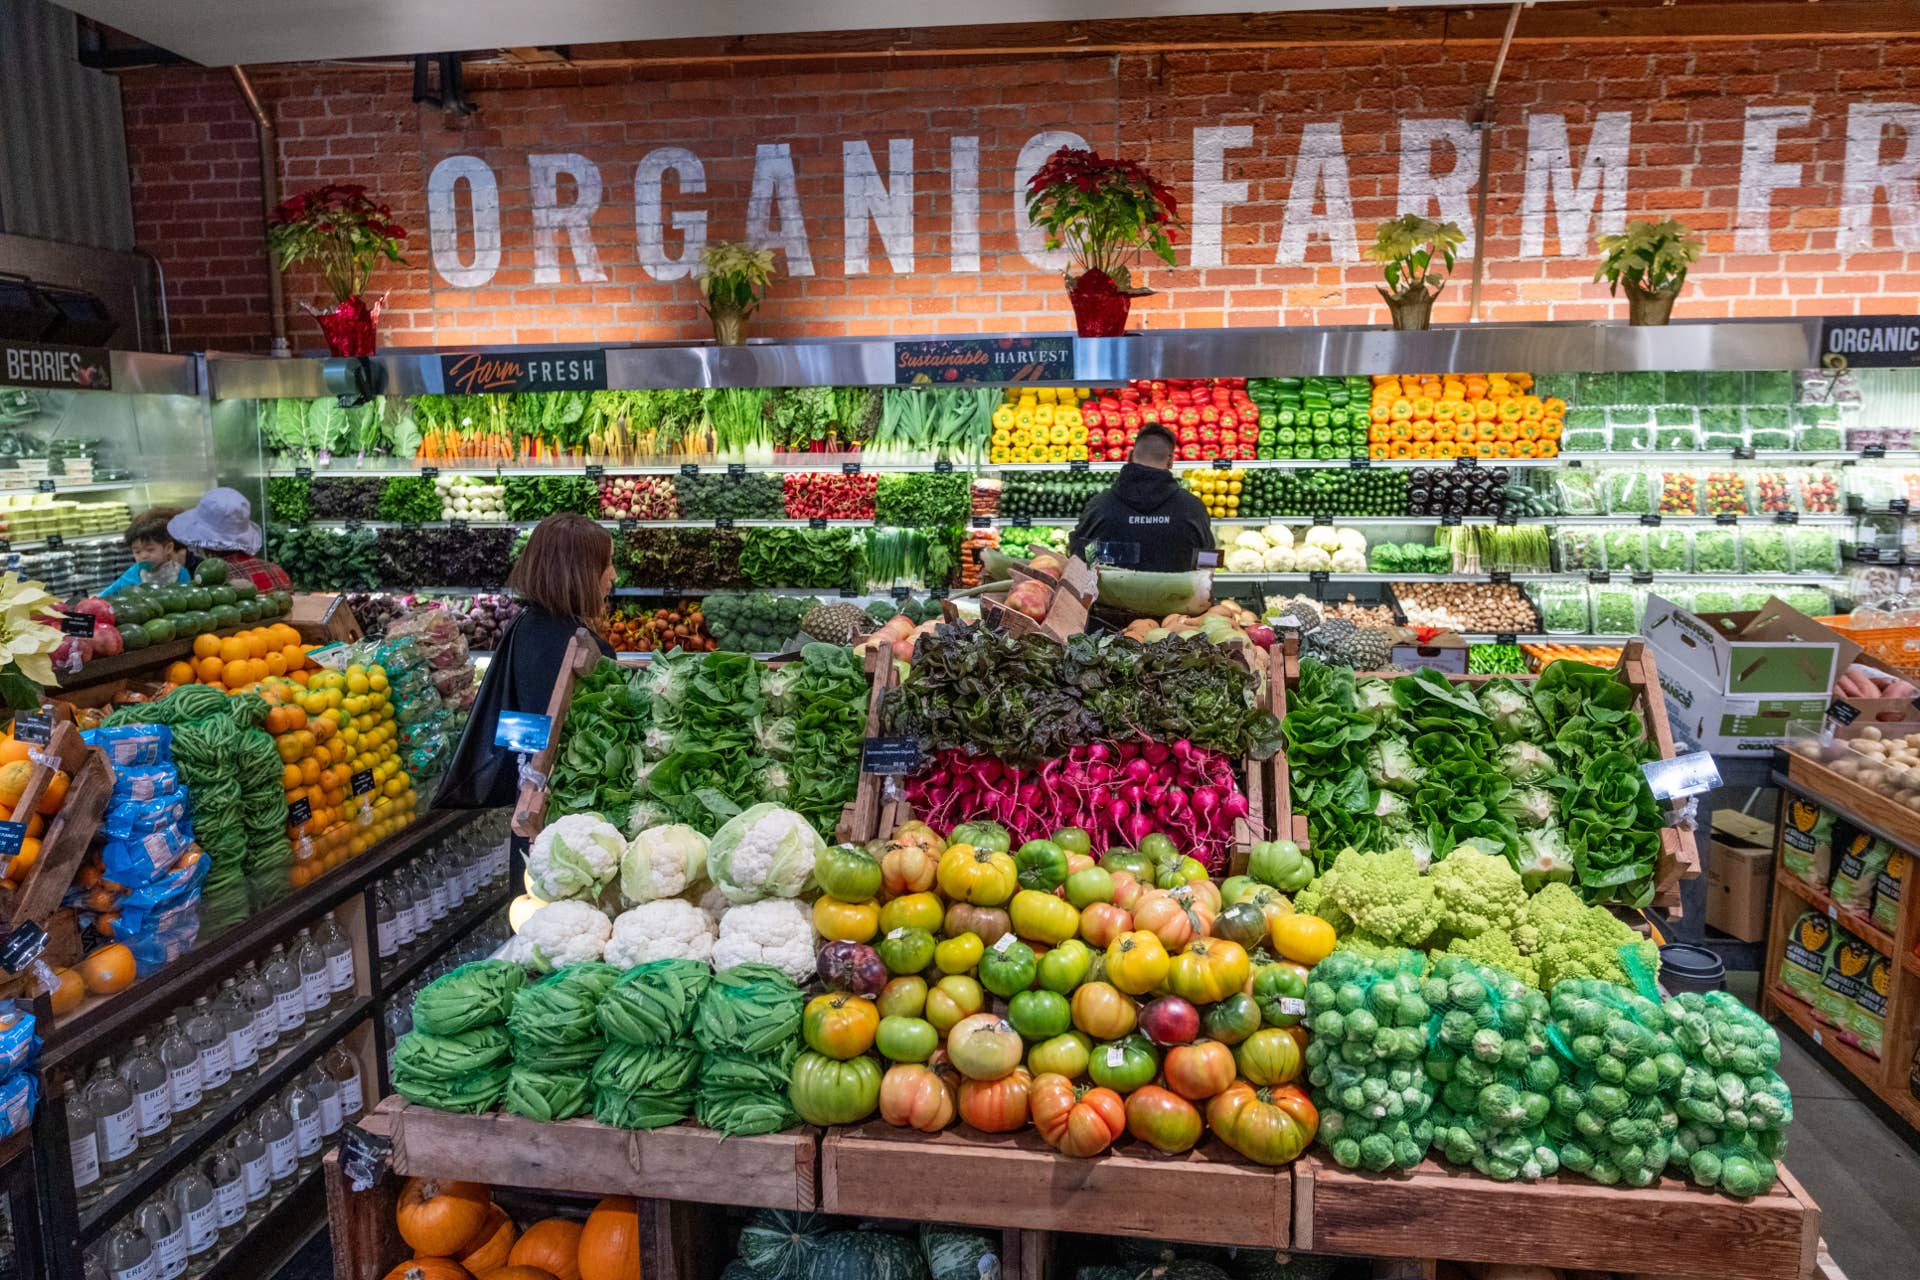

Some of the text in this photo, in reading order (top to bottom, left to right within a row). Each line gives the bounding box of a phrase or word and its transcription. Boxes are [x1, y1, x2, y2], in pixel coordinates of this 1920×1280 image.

[1191, 111, 1632, 266] FARM
[1734, 102, 1920, 252] FR
[1829, 326, 1920, 353] ORGANIC
[6, 348, 81, 382] BERRIES
[898, 349, 1069, 368] Sustainable HARVEST
[449, 354, 595, 394] Farm FRESH
[1128, 515, 1170, 525] EREWHON
